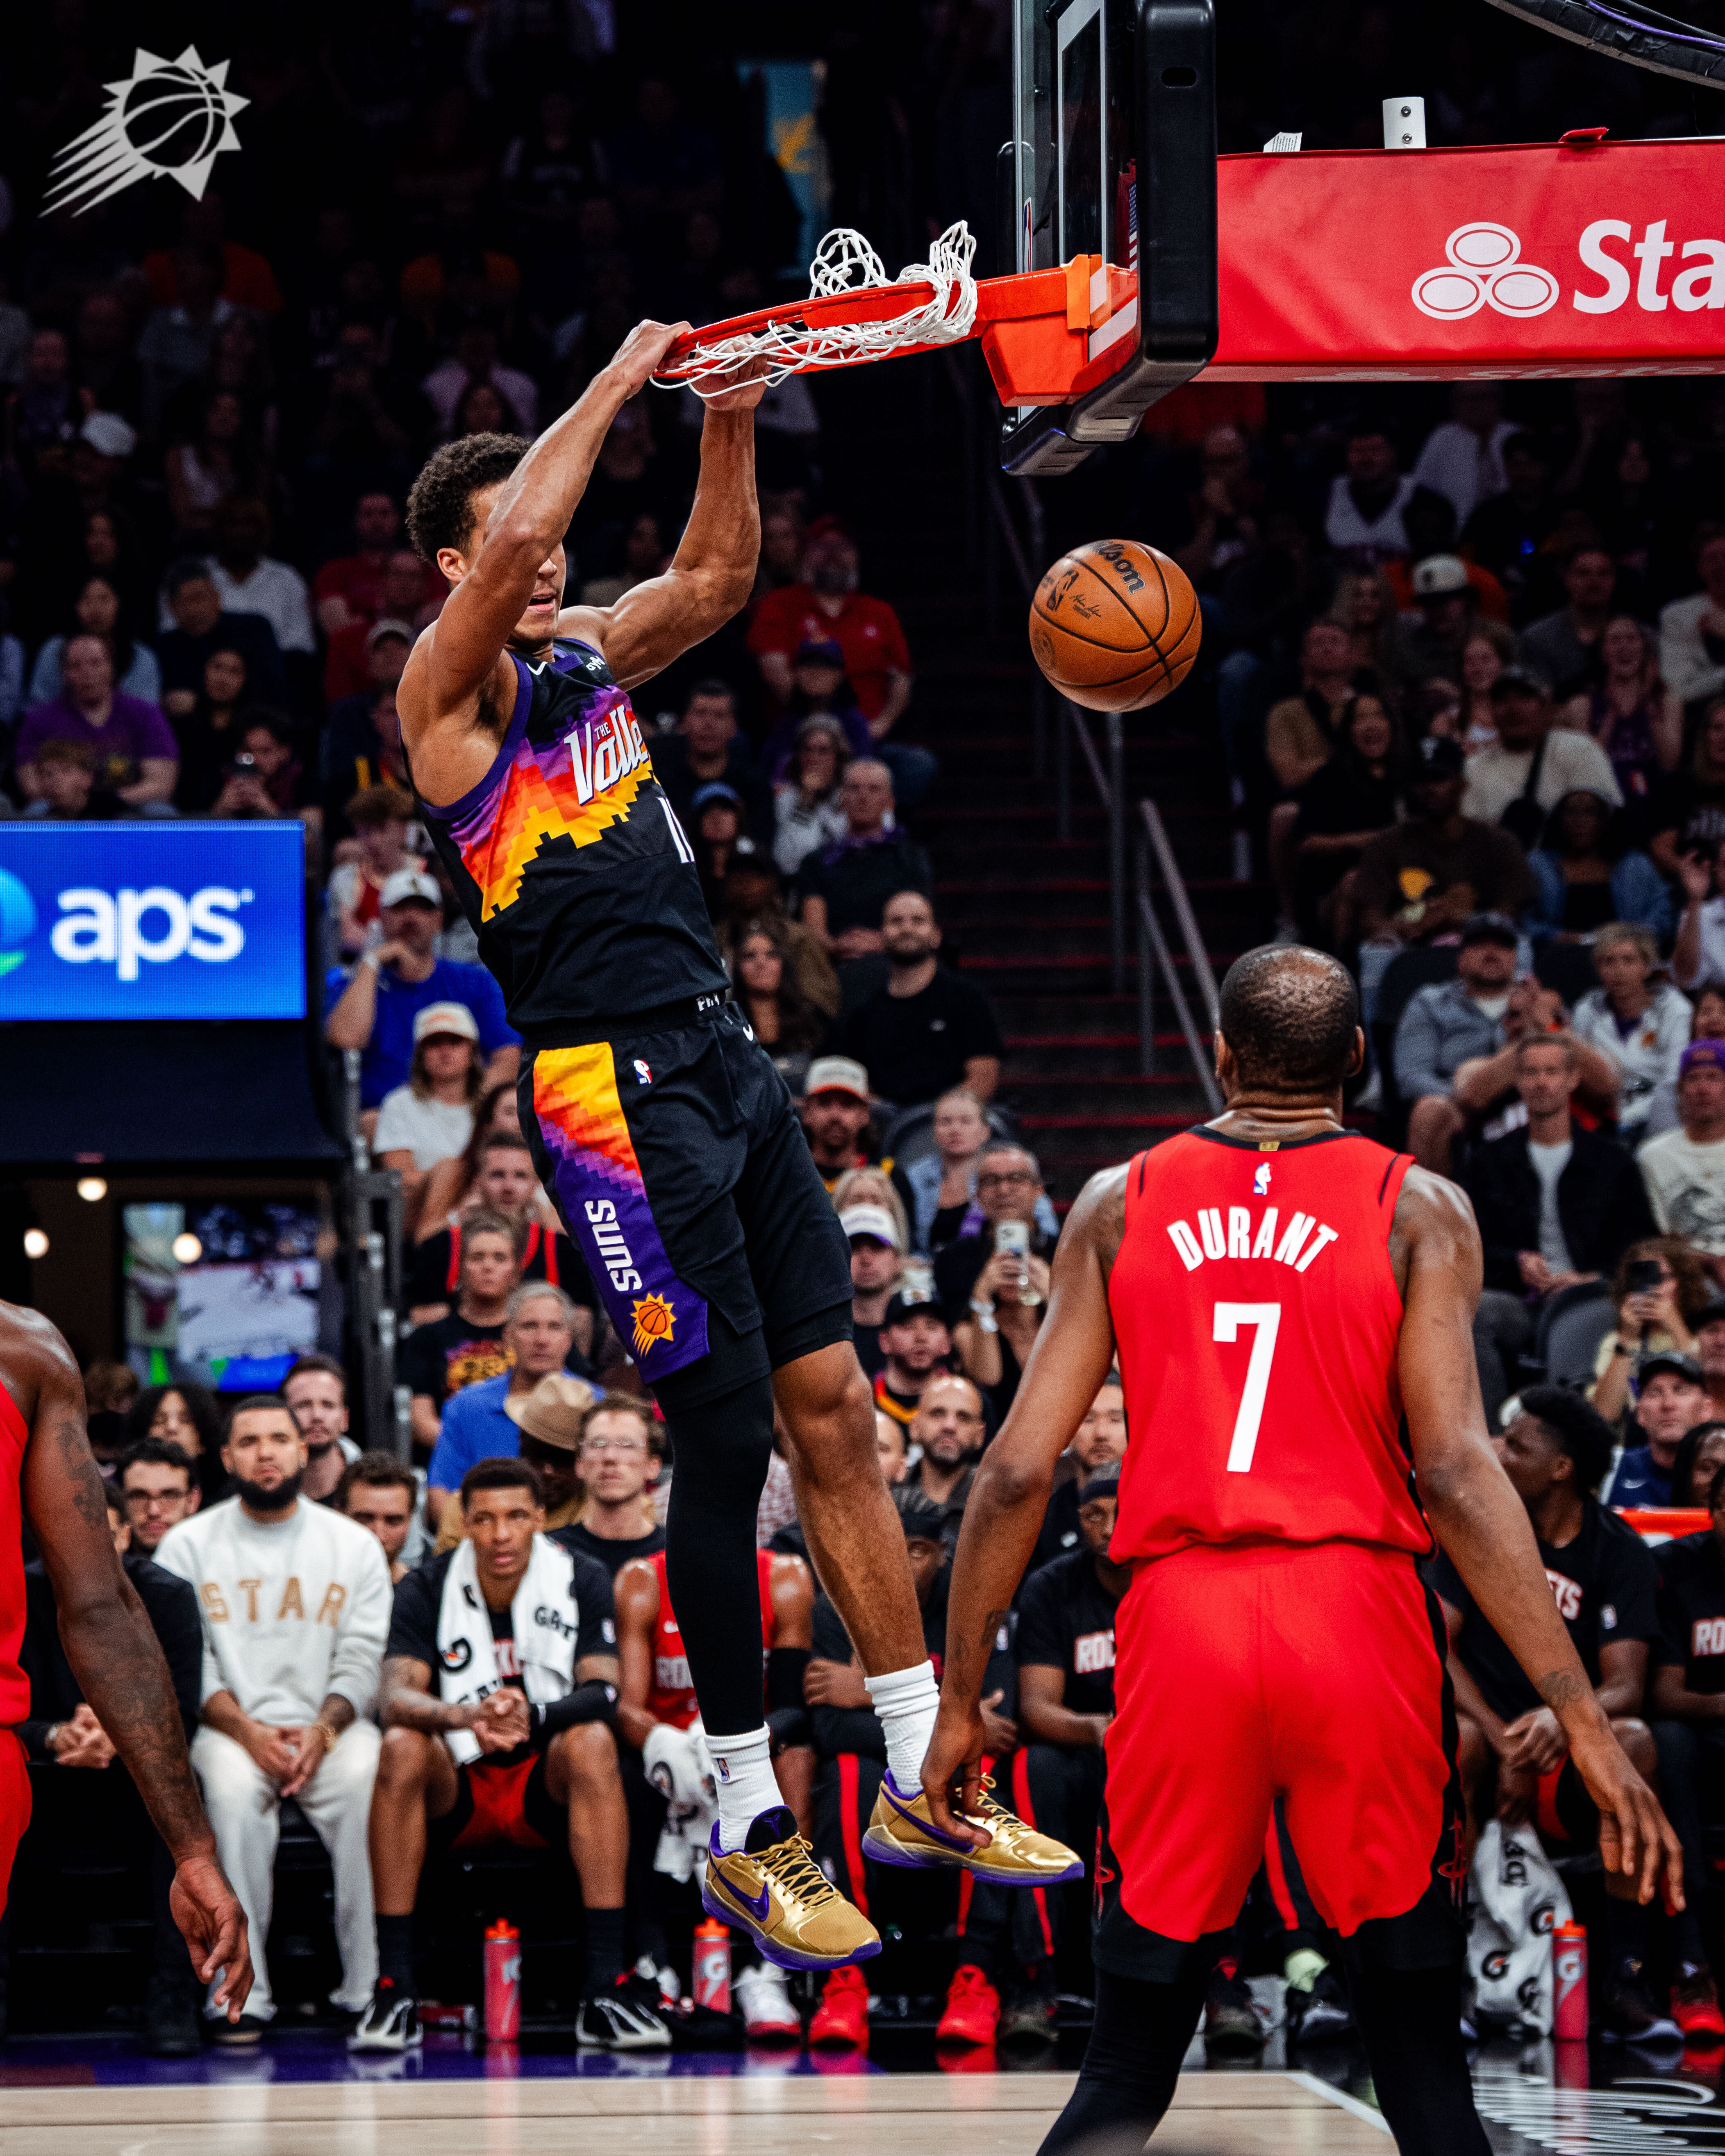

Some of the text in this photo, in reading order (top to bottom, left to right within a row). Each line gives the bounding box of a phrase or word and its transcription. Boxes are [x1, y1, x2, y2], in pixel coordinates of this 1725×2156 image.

[594, 722, 612, 740] THE
[50, 886, 247, 981] aps
[1167, 1206, 1339, 1272] DURANT
[1214, 1302, 1281, 1473] 7
[200, 1576, 348, 1627] STAR
